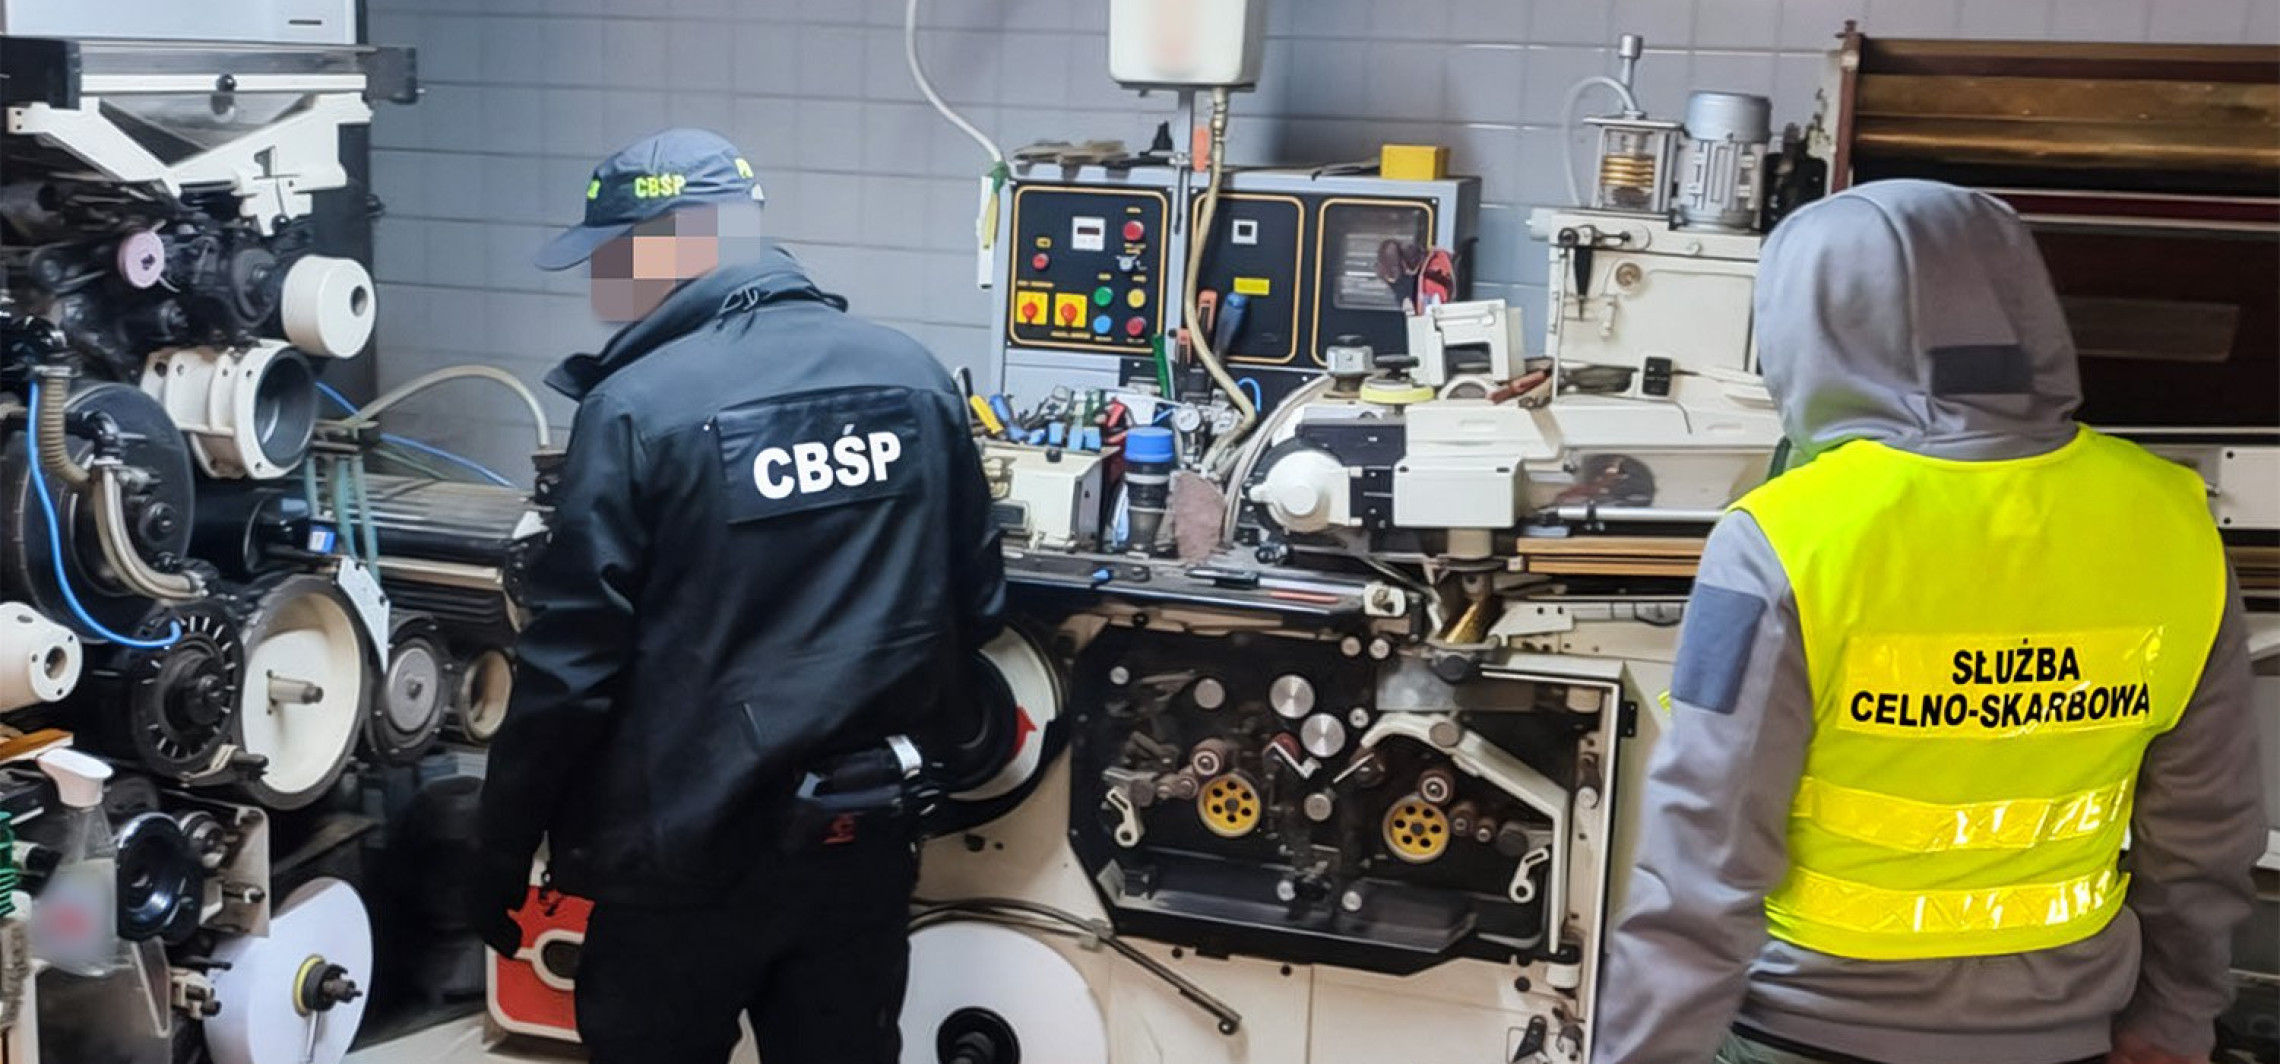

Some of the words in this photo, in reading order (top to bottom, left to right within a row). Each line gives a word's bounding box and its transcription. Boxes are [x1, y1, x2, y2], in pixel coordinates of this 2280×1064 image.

[635, 172, 685, 198] CBŚP
[753, 423, 901, 500] CBŚP
[1952, 637, 2081, 685] SŁUŻBA
[1850, 682, 2150, 728] CELNO-SKARBOWA
